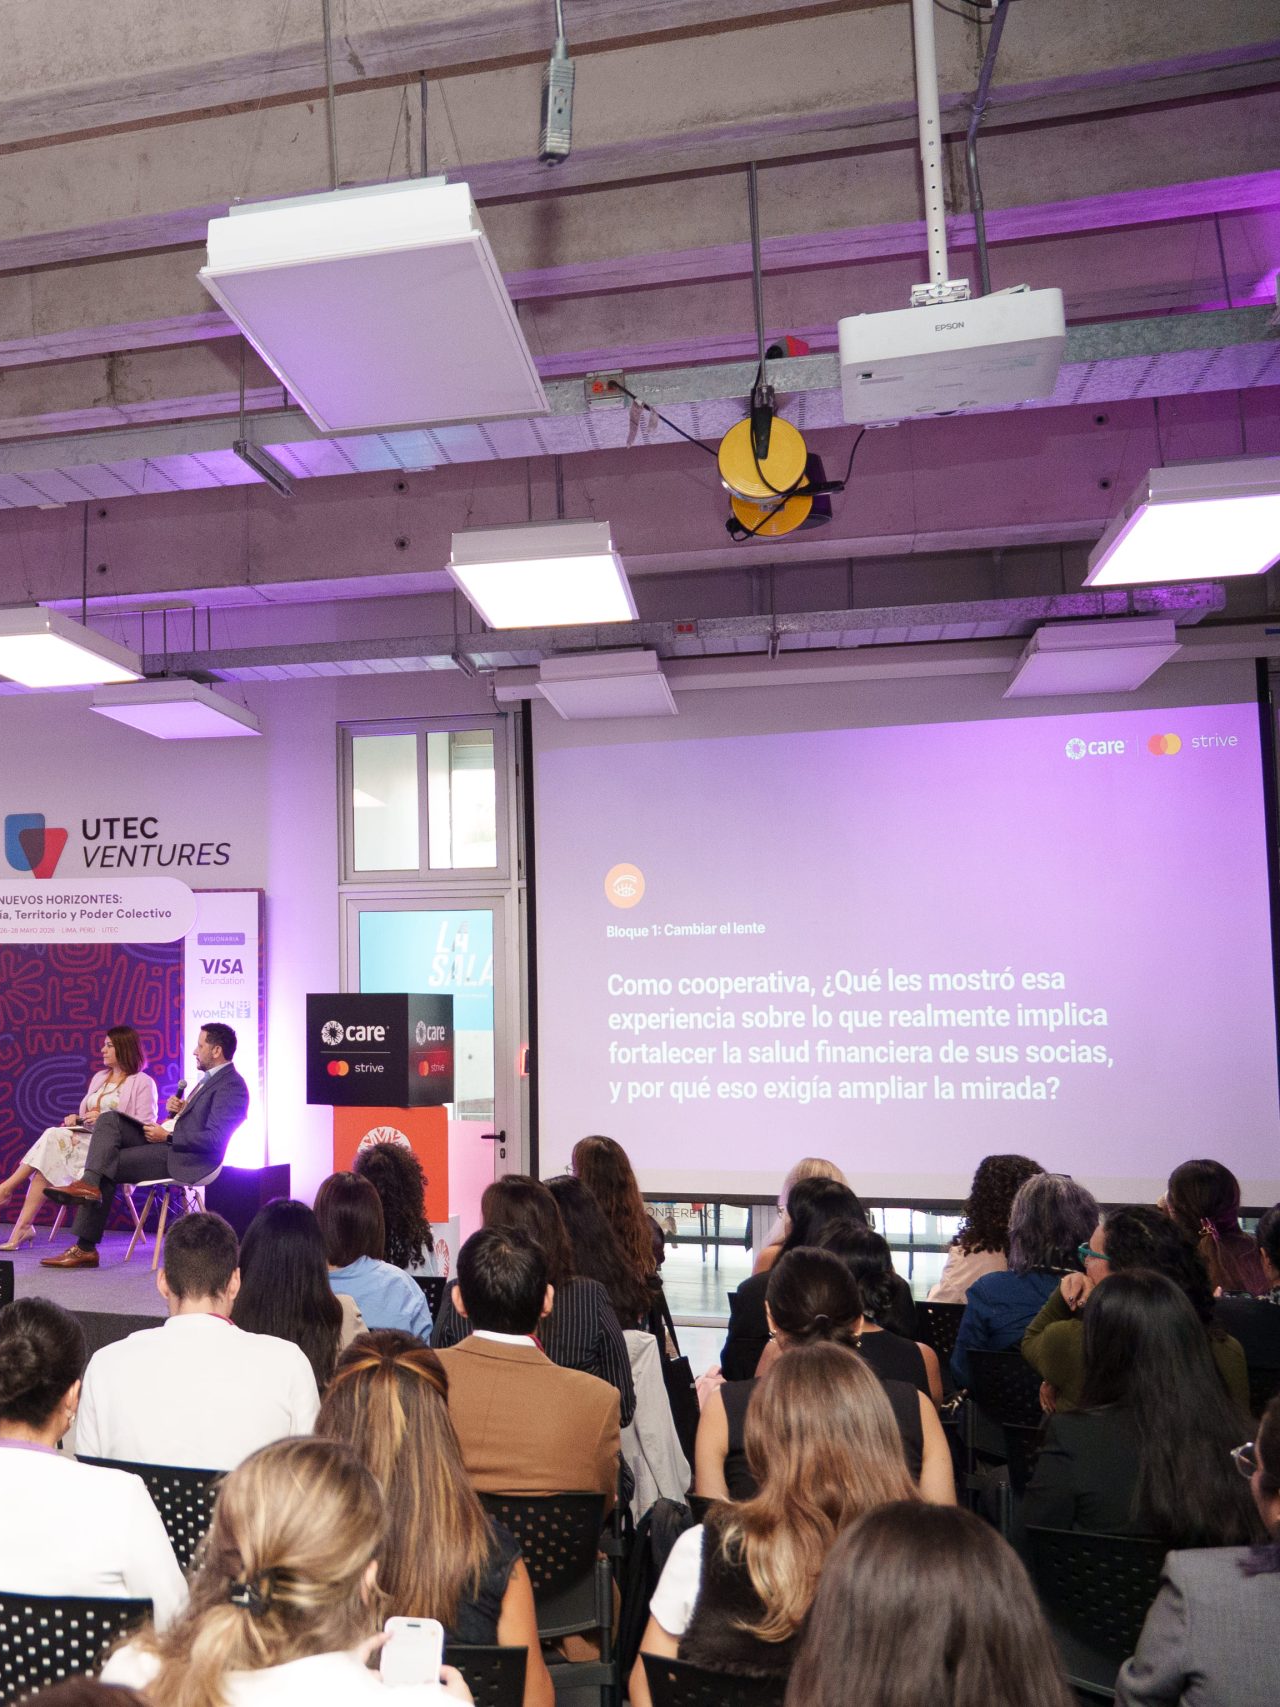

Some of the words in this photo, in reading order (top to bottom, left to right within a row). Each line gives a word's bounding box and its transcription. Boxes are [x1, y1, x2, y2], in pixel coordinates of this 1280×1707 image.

[934, 321, 965, 332] EPSON
[1088, 740, 1124, 755] care
[1191, 732, 1238, 748] strive
[82, 816, 159, 841] UTEC
[82, 842, 232, 868] VENTURES
[46, 894, 122, 904] HORIZONTES:
[15, 910, 67, 919] Territorio
[70, 912, 77, 921] y
[80, 909, 113, 919] Poder
[116, 908, 172, 919] Colectivo
[606, 924, 649, 940] Bloque
[652, 924, 662, 936] 1:
[664, 923, 717, 936] Cambiar
[720, 922, 731, 934] el
[733, 922, 766, 935] lente
[199, 959, 244, 974] VISA
[200, 977, 245, 985] Foundation
[607, 973, 672, 996] Como
[678, 970, 816, 1000] cooperativa,
[822, 968, 882, 997] ¿Qué
[888, 968, 922, 992] les
[928, 966, 1015, 992] mostró
[1021, 971, 1065, 990] esa
[219, 1001, 234, 1009] UN
[192, 1009, 234, 1018] WOMEN
[608, 1006, 736, 1035] experiencia
[742, 1004, 806, 1029] sobre
[812, 1004, 833, 1028] lo
[839, 1009, 882, 1034] que
[889, 1003, 1010, 1028] realmente
[1017, 1001, 1108, 1032] implica
[345, 1025, 386, 1042] care
[426, 1025, 445, 1041] care
[608, 1041, 717, 1064] fortalecer
[722, 1040, 742, 1064] la
[748, 1040, 810, 1064] salud
[815, 1039, 933, 1064] financiera
[939, 1039, 969, 1063] de
[976, 1044, 1019, 1064] sus
[1025, 1039, 1114, 1068] socias,
[354, 1062, 384, 1073] strive
[430, 1061, 445, 1072] strive
[608, 1081, 622, 1104] y
[627, 1080, 665, 1104] por
[670, 1075, 711, 1104] qué
[717, 1080, 758, 1099] eso
[763, 1075, 832, 1104] exigía
[838, 1075, 928, 1105] ampliar
[934, 1075, 955, 1100] la
[961, 1074, 1060, 1100] mirada?
